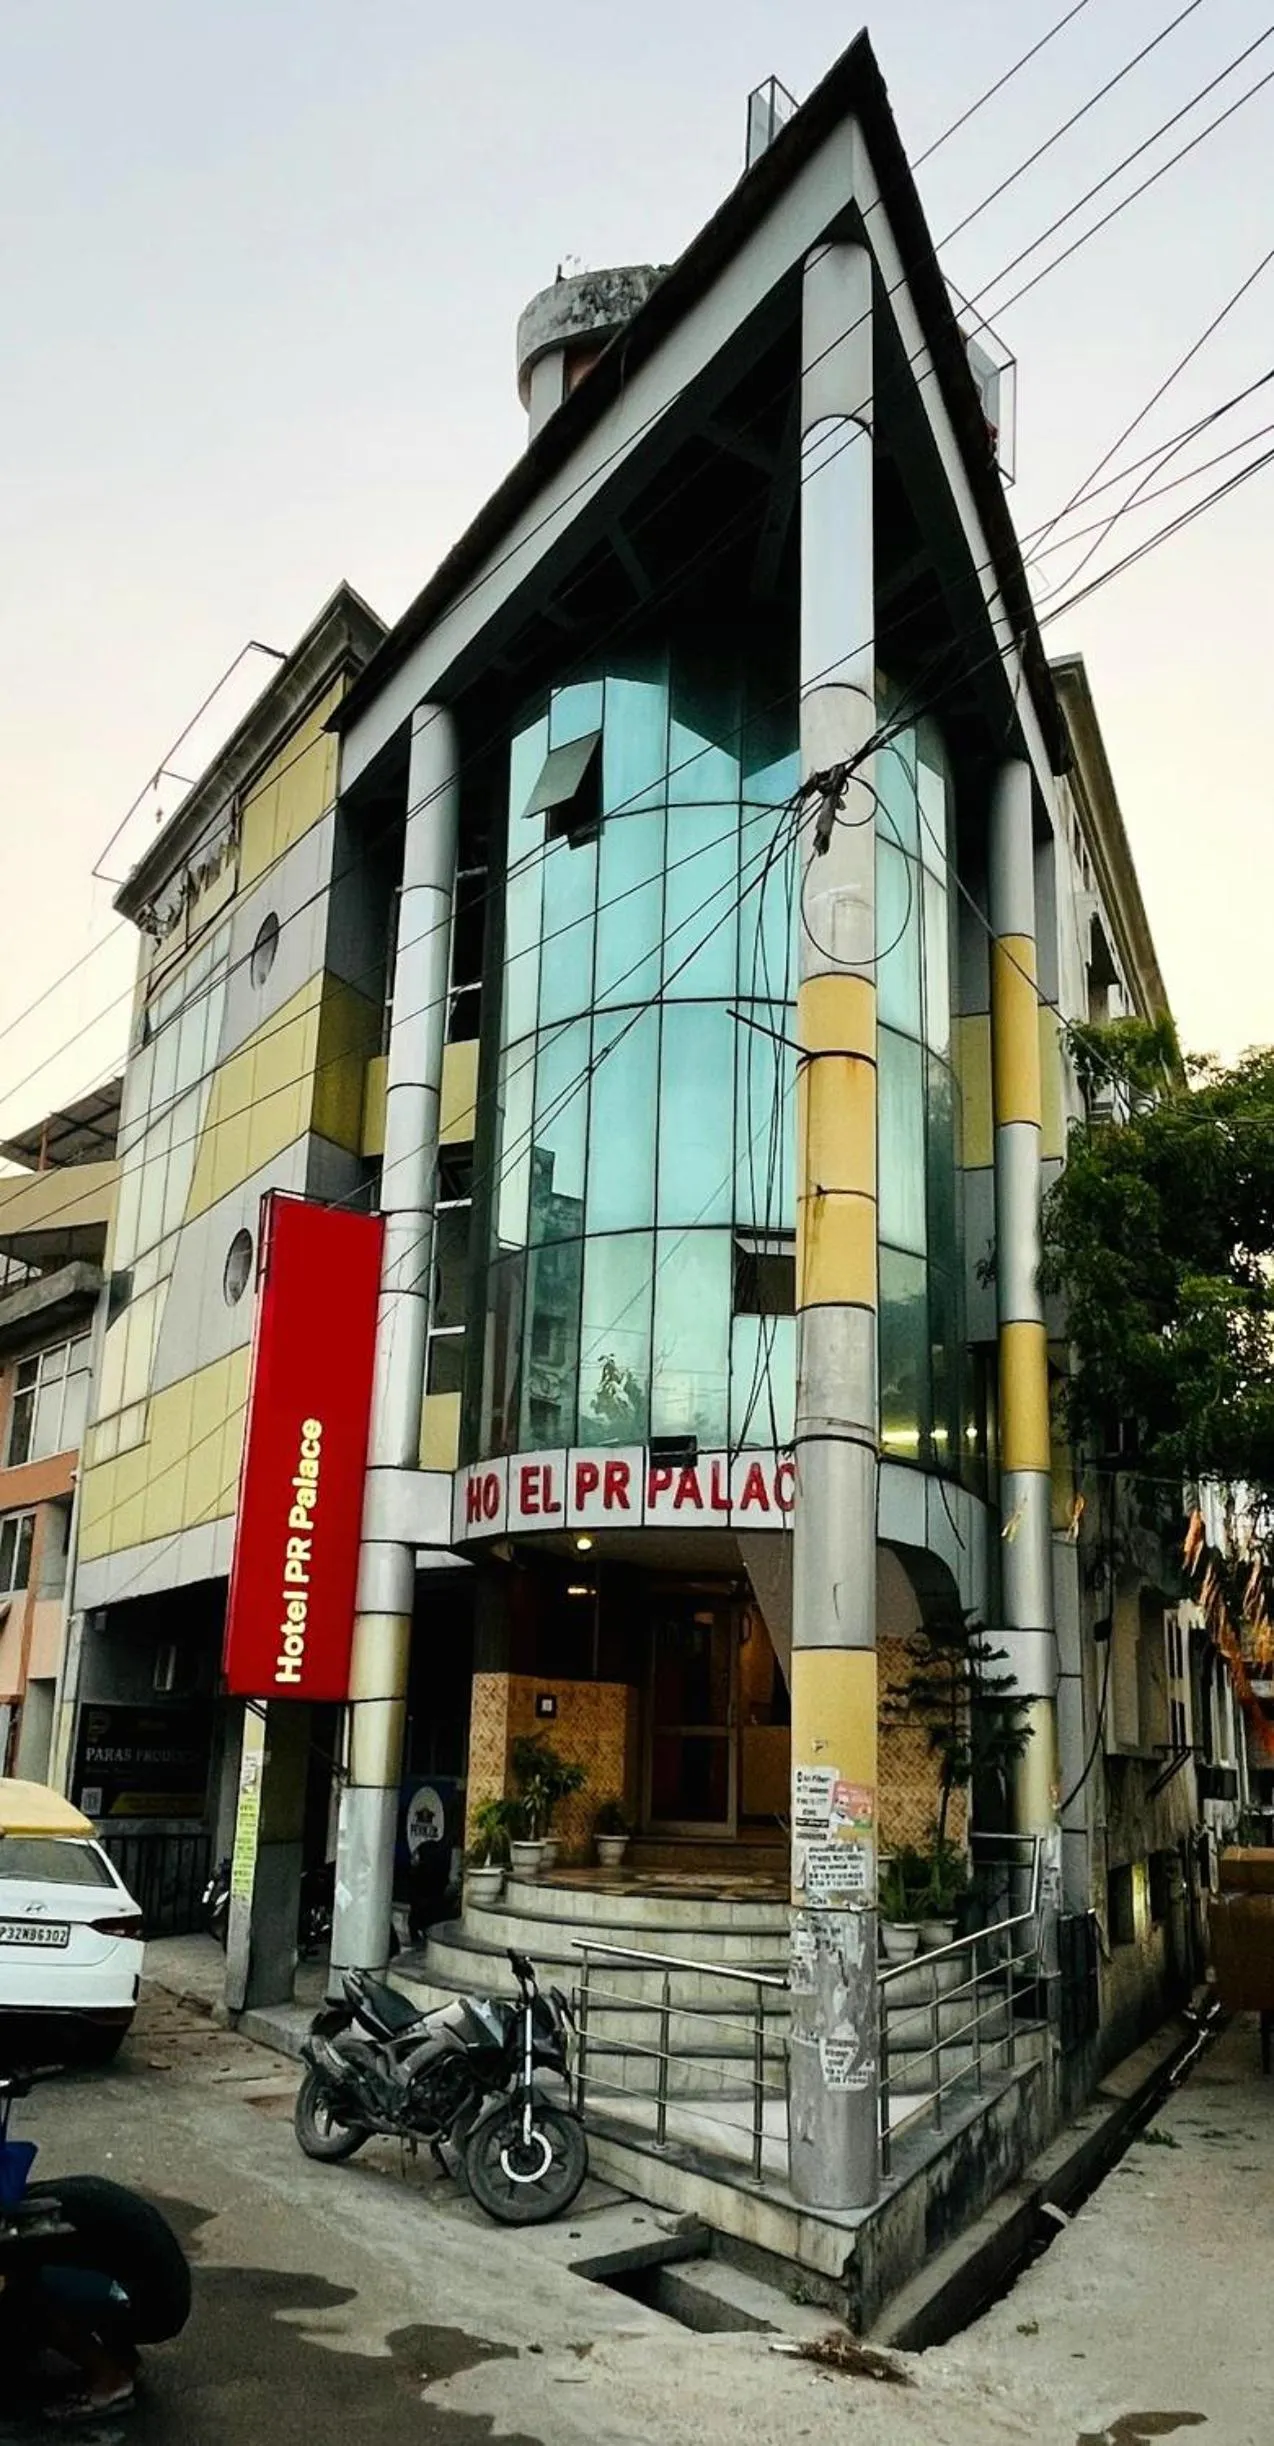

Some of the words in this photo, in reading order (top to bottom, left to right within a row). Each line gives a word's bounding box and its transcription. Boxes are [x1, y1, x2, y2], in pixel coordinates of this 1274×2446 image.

[288, 1418, 322, 1530] Palace
[575, 1460, 630, 1511] PR
[648, 1460, 795, 1512] PALAC
[284, 1536, 312, 1583] PR
[275, 1591, 308, 1683] Hotel
[85, 1747, 132, 1762] PARAS
[0, 1926, 67, 1942] P32NB6302
